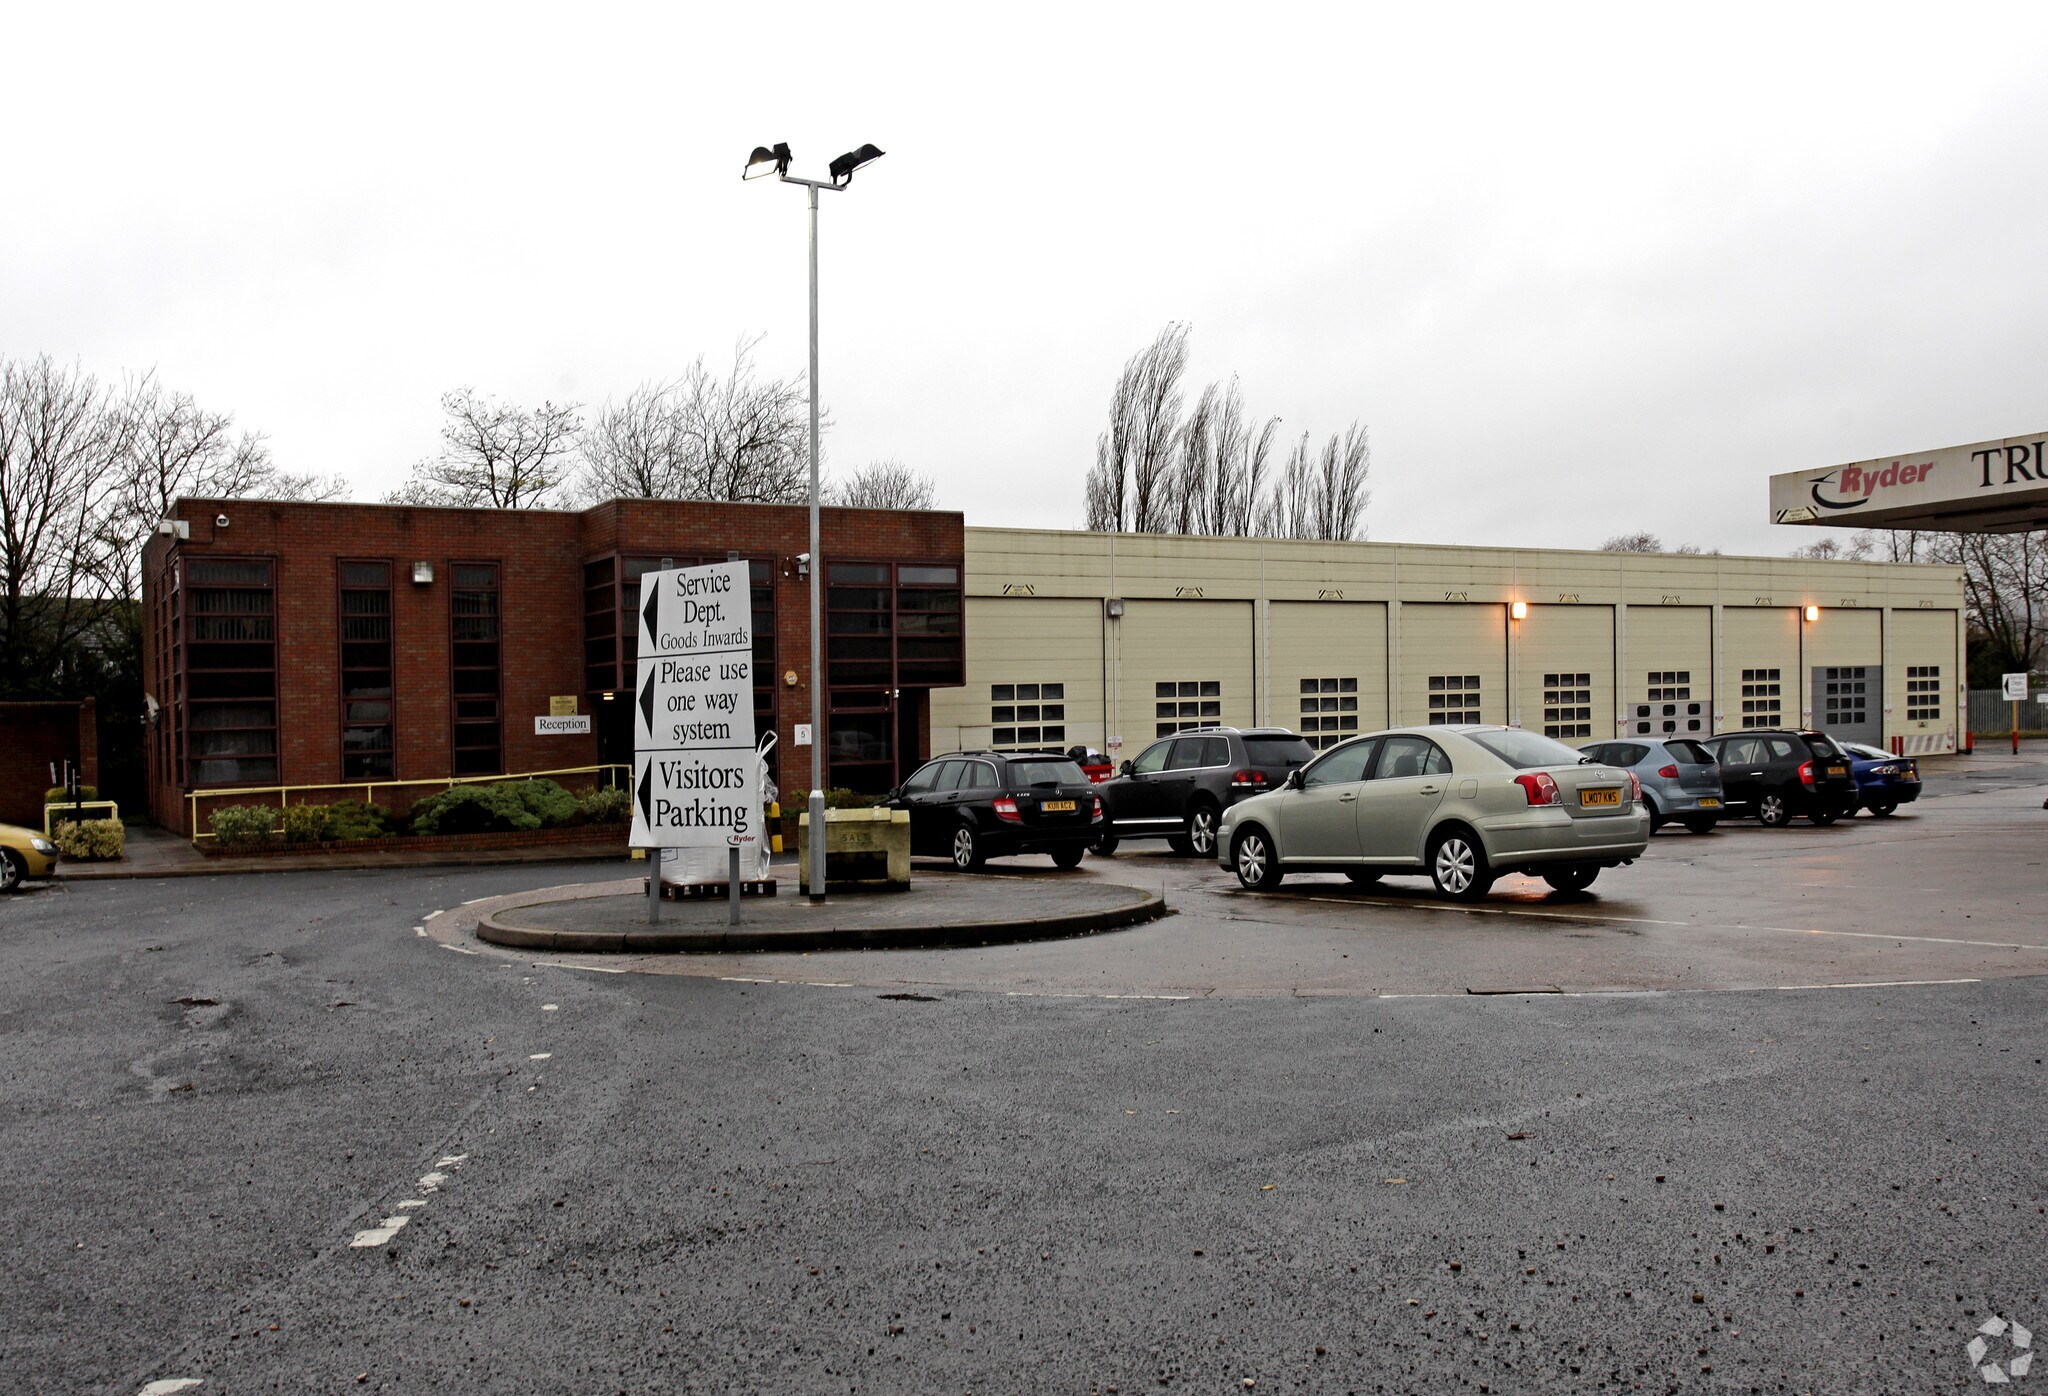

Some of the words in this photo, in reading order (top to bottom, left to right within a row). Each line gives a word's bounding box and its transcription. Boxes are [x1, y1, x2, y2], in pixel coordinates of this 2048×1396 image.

[1839, 461, 1934, 497] Ryder
[676, 569, 731, 597] Service
[683, 600, 726, 627] Dept.
[660, 631, 698, 650] Goods
[703, 627, 748, 647] Inwards
[660, 661, 711, 684] Please
[720, 662, 748, 680] use
[667, 695, 696, 712] one
[704, 693, 739, 714] way
[539, 718, 587, 731] Reception
[672, 720, 731, 745] system
[800, 730, 806, 739] 5
[659, 760, 744, 789] Visitors
[1584, 793, 1602, 804] LM07
[1604, 792, 1617, 803] KWS
[655, 797, 748, 833] Parking
[733, 835, 756, 843] Ryder
